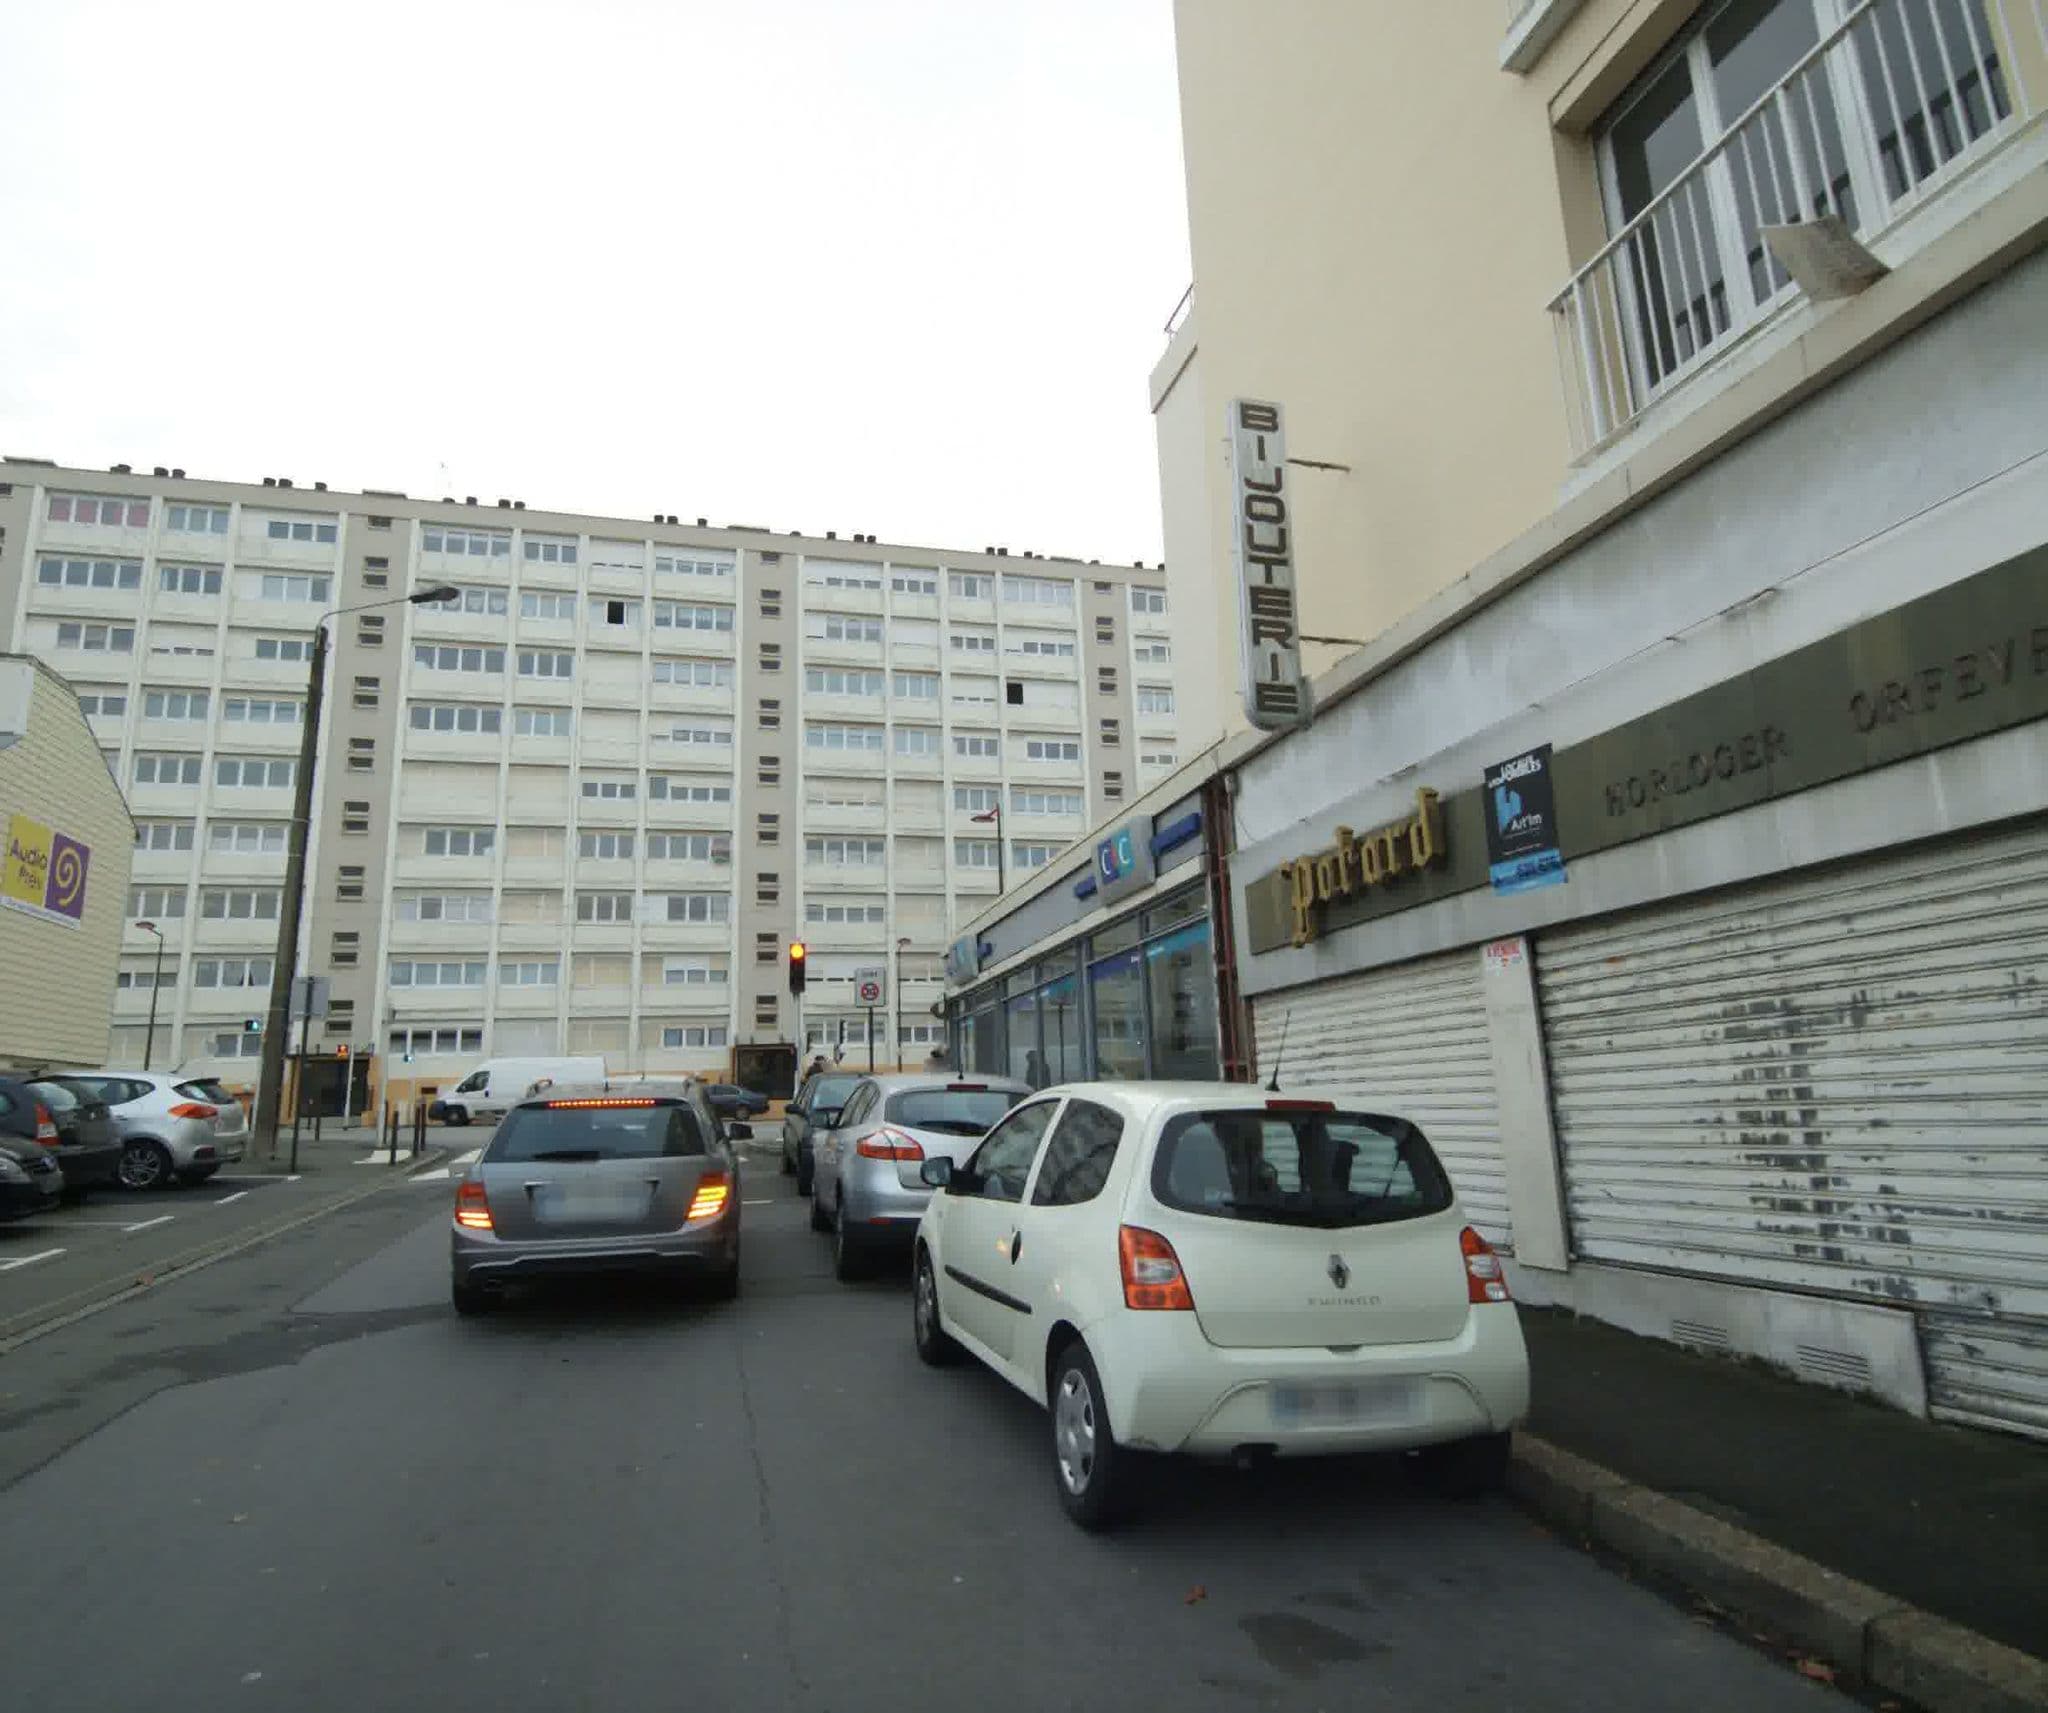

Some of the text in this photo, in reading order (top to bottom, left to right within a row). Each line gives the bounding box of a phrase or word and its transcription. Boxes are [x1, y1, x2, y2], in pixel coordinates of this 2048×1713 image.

[1240, 402, 1299, 715] BIJOUTERIE
[1604, 724, 1789, 817] HORLOGER
[9, 838, 48, 871] Audio
